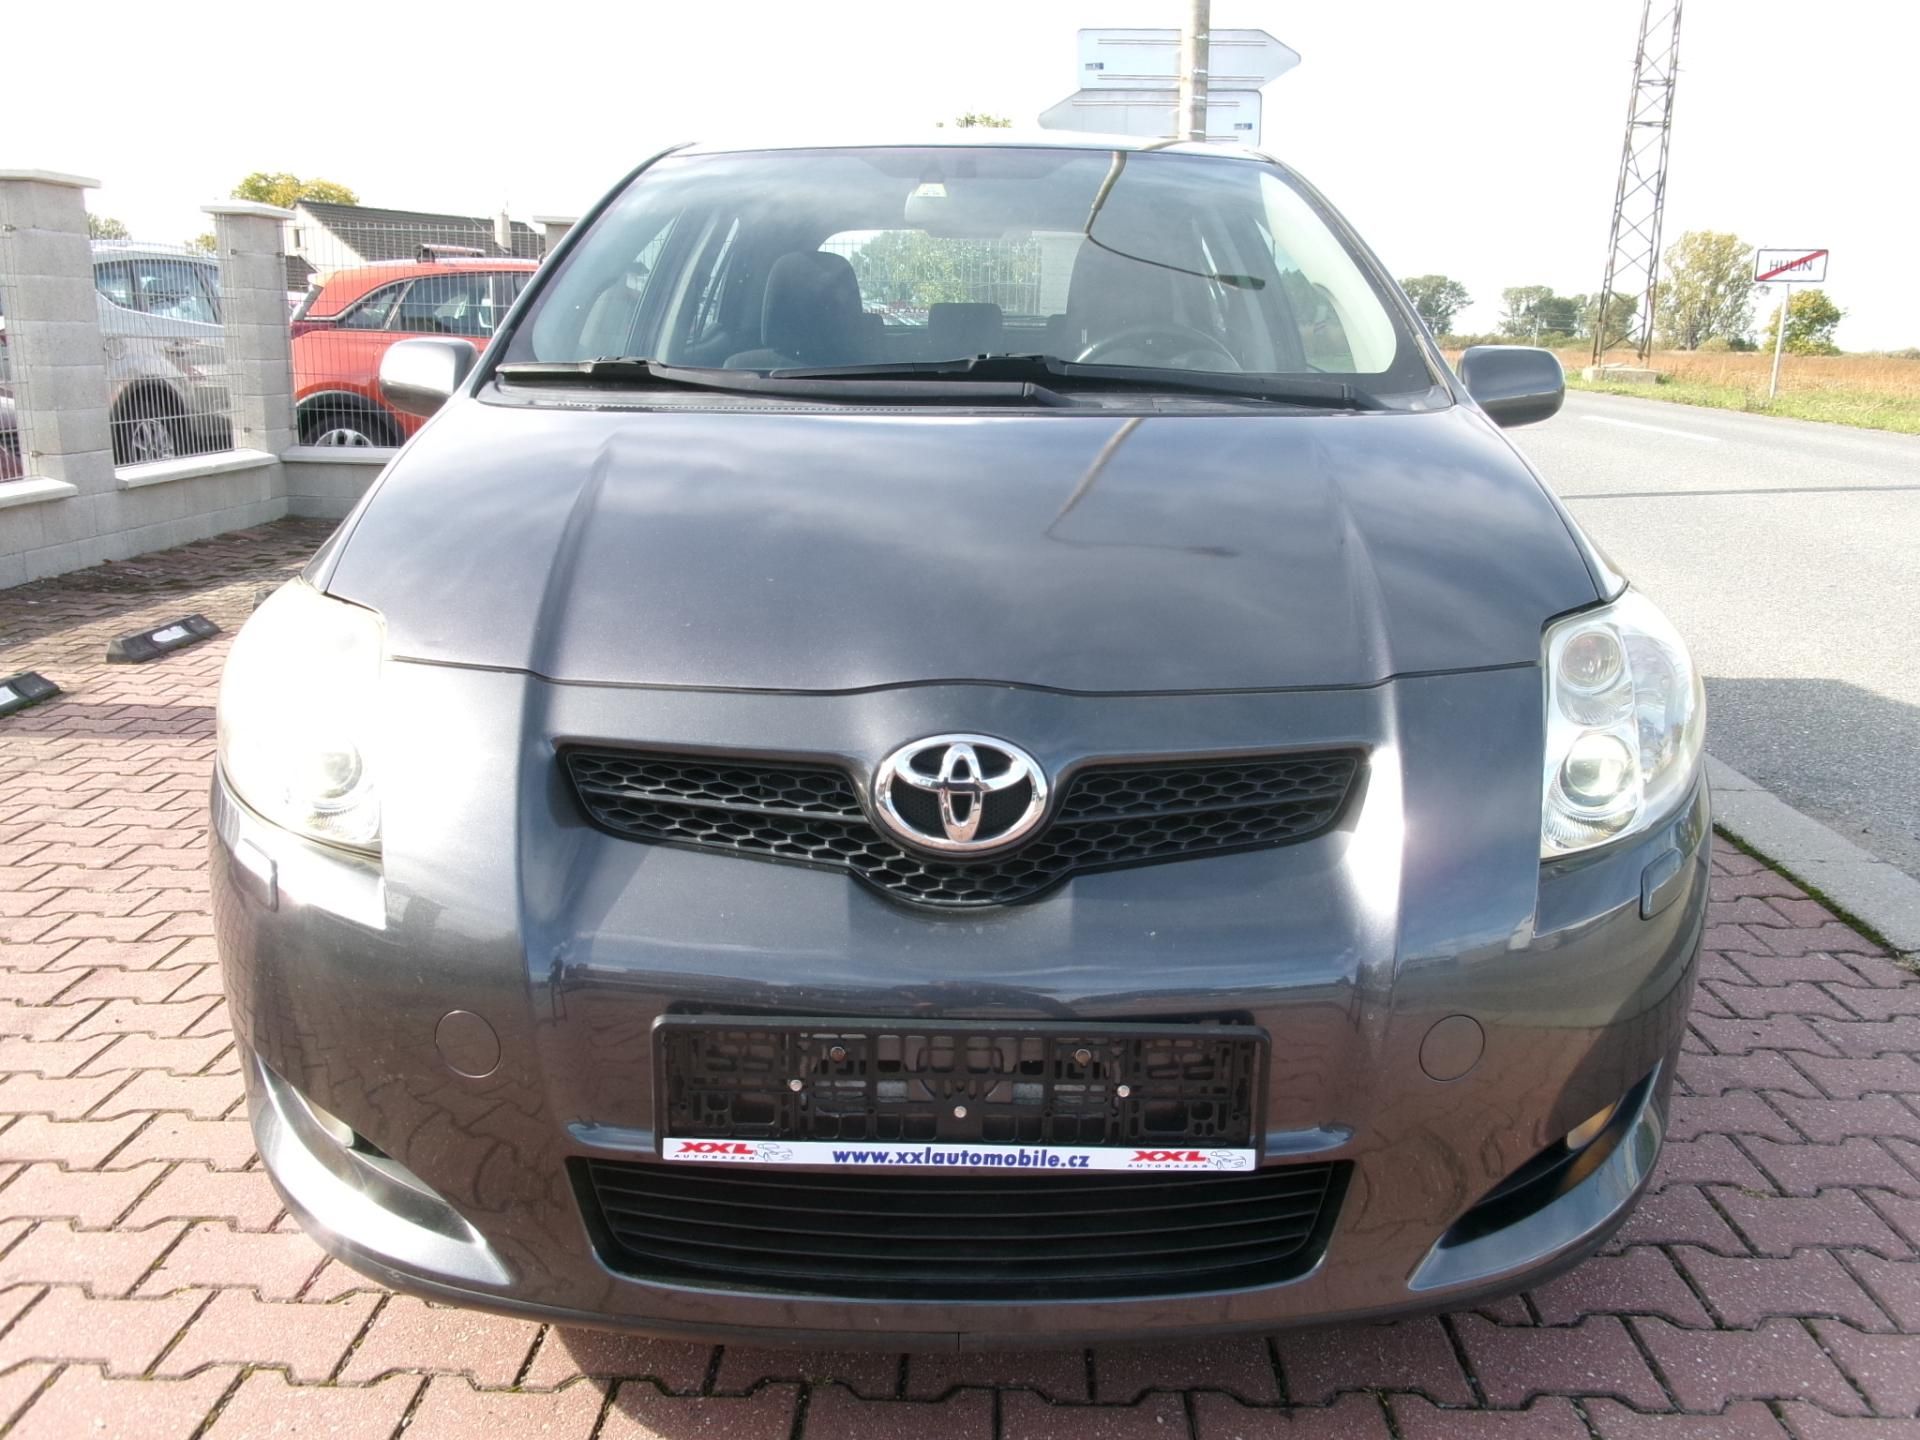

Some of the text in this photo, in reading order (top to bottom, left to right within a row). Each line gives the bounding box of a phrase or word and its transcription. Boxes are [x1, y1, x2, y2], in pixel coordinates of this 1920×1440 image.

[676, 1142, 754, 1154] XXL
[832, 1147, 1090, 1168] www.xxlautomobile.cz
[1131, 1150, 1206, 1162] XXL
